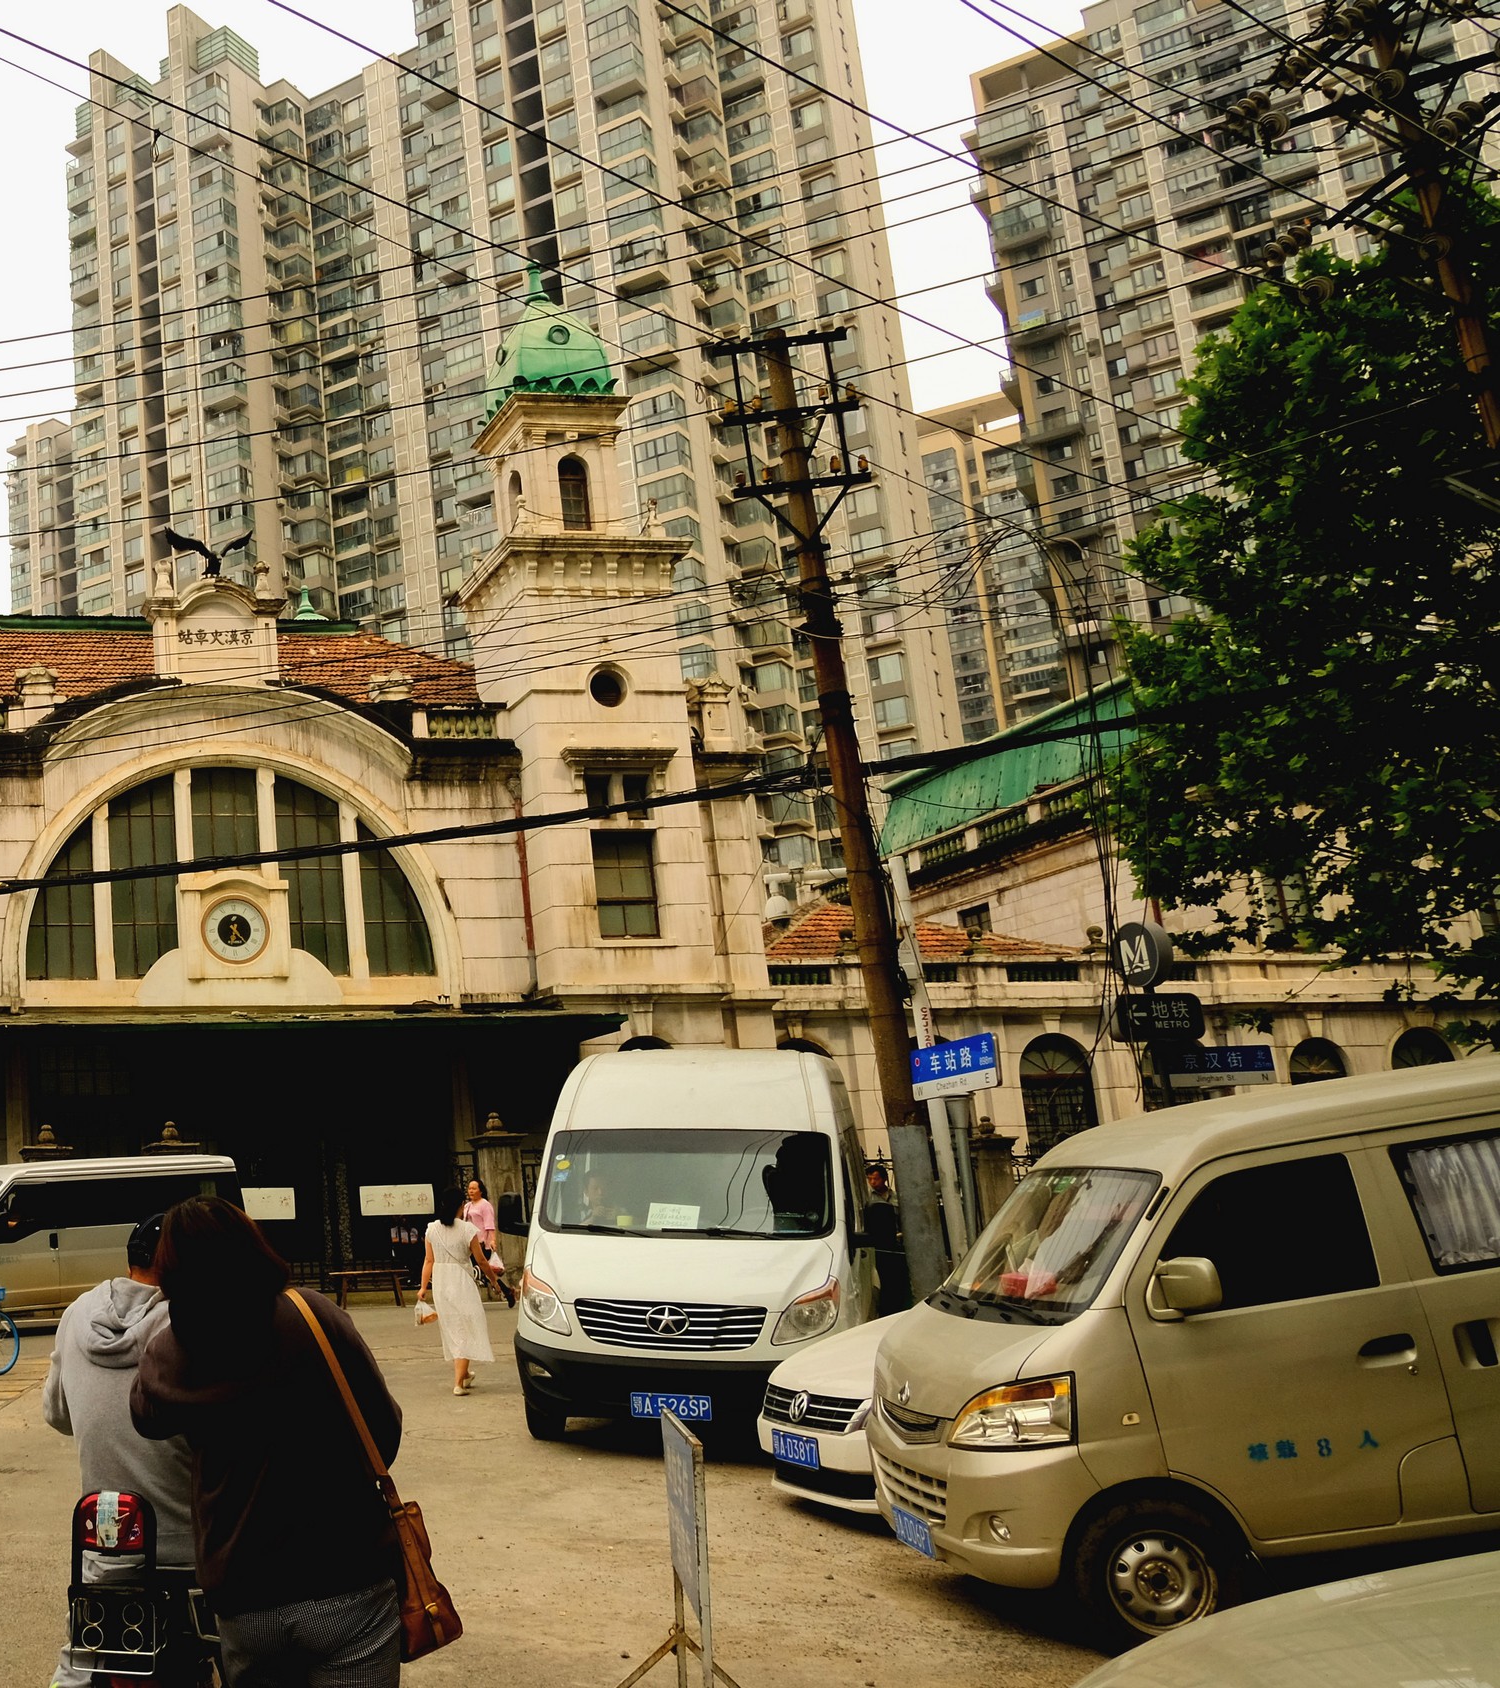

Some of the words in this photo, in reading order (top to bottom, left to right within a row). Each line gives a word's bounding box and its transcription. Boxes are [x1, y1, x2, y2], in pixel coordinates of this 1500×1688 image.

[1151, 1001, 1190, 1019] 地铁
[1155, 1020, 1191, 1029] METRO
[930, 1046, 972, 1075] 车站路
[1183, 1051, 1243, 1070] 京汉街
[985, 1072, 991, 1084] E
[1261, 1073, 1269, 1081] N
[1316, 1438, 1332, 1457] 8
[1359, 1430, 1379, 1449] 人
